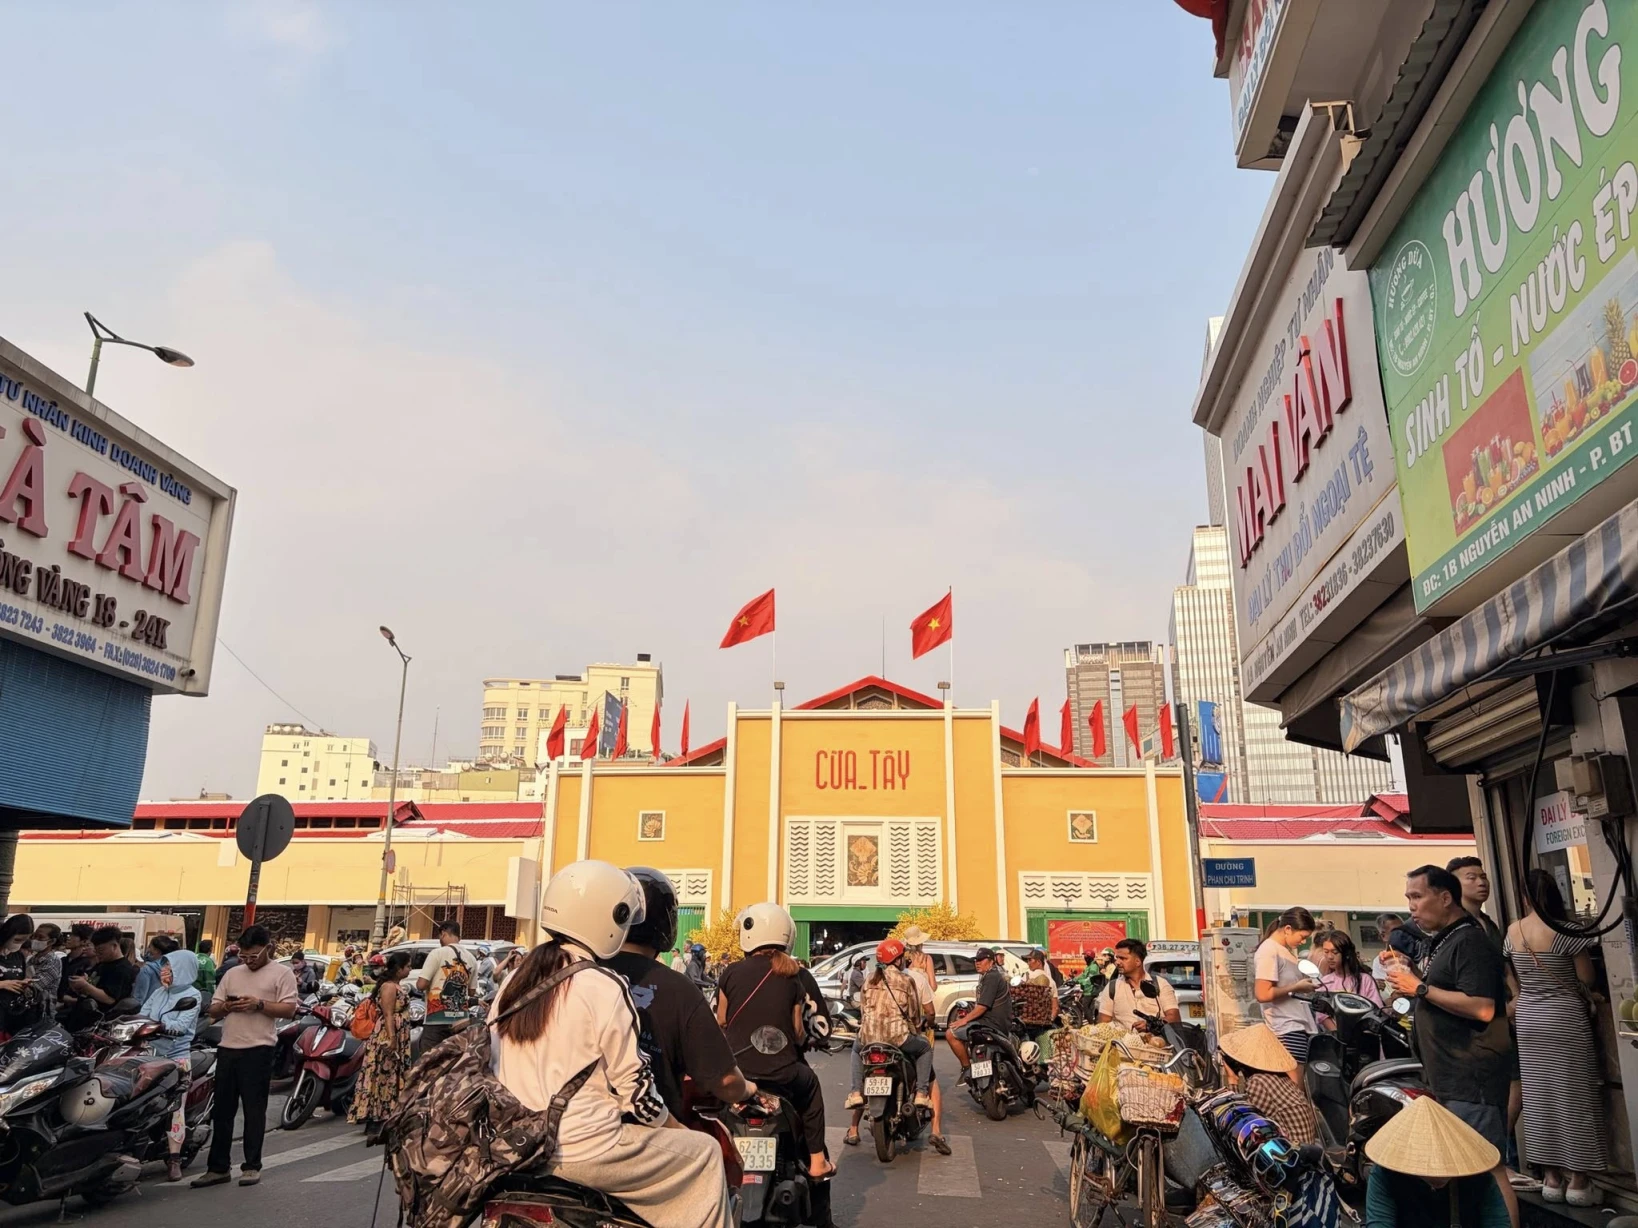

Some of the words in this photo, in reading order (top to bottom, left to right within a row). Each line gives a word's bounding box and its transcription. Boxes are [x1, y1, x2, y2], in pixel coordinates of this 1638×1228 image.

[1443, 0, 1622, 318] HƯƠNG
[1232, 407, 1258, 464] DOANH
[1256, 338, 1286, 417] NGHIỆP
[1287, 297, 1303, 350] TƯ
[1302, 247, 1335, 321] NHÂN
[1405, 373, 1450, 468] SINH
[1455, 309, 1484, 410] TỐ
[1510, 220, 1586, 357] NƯỚC
[1593, 161, 1638, 264] ÉP
[22, 388, 70, 432] NHÂN
[70, 419, 109, 456] KINH
[110, 443, 159, 486] DOANH
[159, 473, 193, 506] VÀNG
[1237, 420, 1286, 568] MAI
[1279, 297, 1352, 484] VÂN
[0, 417, 48, 538] À
[67, 472, 200, 604] TÂM
[1248, 590, 1262, 628] ĐẠI
[1261, 562, 1274, 612] LÝ
[1273, 542, 1292, 592] THU
[1292, 502, 1312, 569] ĐỔI
[1311, 460, 1351, 541] NGOẠI
[1348, 425, 1374, 487] TỆ
[1351, 511, 1395, 575] 38237630
[1423, 573, 1442, 598] ĐC:
[1442, 561, 1458, 582] 1B
[1459, 518, 1510, 570] NGUYỄN
[1513, 501, 1533, 531] AN
[1536, 466, 1576, 513] NINH
[1590, 446, 1606, 471] P.
[1608, 421, 1634, 457] BT
[0, 602, 19, 625] 823
[20, 610, 44, 634] 7243
[52, 623, 73, 646] 3822
[75, 631, 97, 654] 3964
[37, 564, 91, 618] VÀNG
[92, 593, 117, 628] 18
[132, 609, 171, 650] 24K
[1541, 806, 1556, 828] ĐẠI
[1556, 797, 1567, 821] LÝ
[1546, 827, 1572, 845] FOREIGN
[1208, 875, 1224, 885] PHAN
[1236, 874, 1254, 884] TRINH
[1215, 862, 1244, 871] ĐƯỜNG
[739, 1140, 769, 1154] 62-F1
